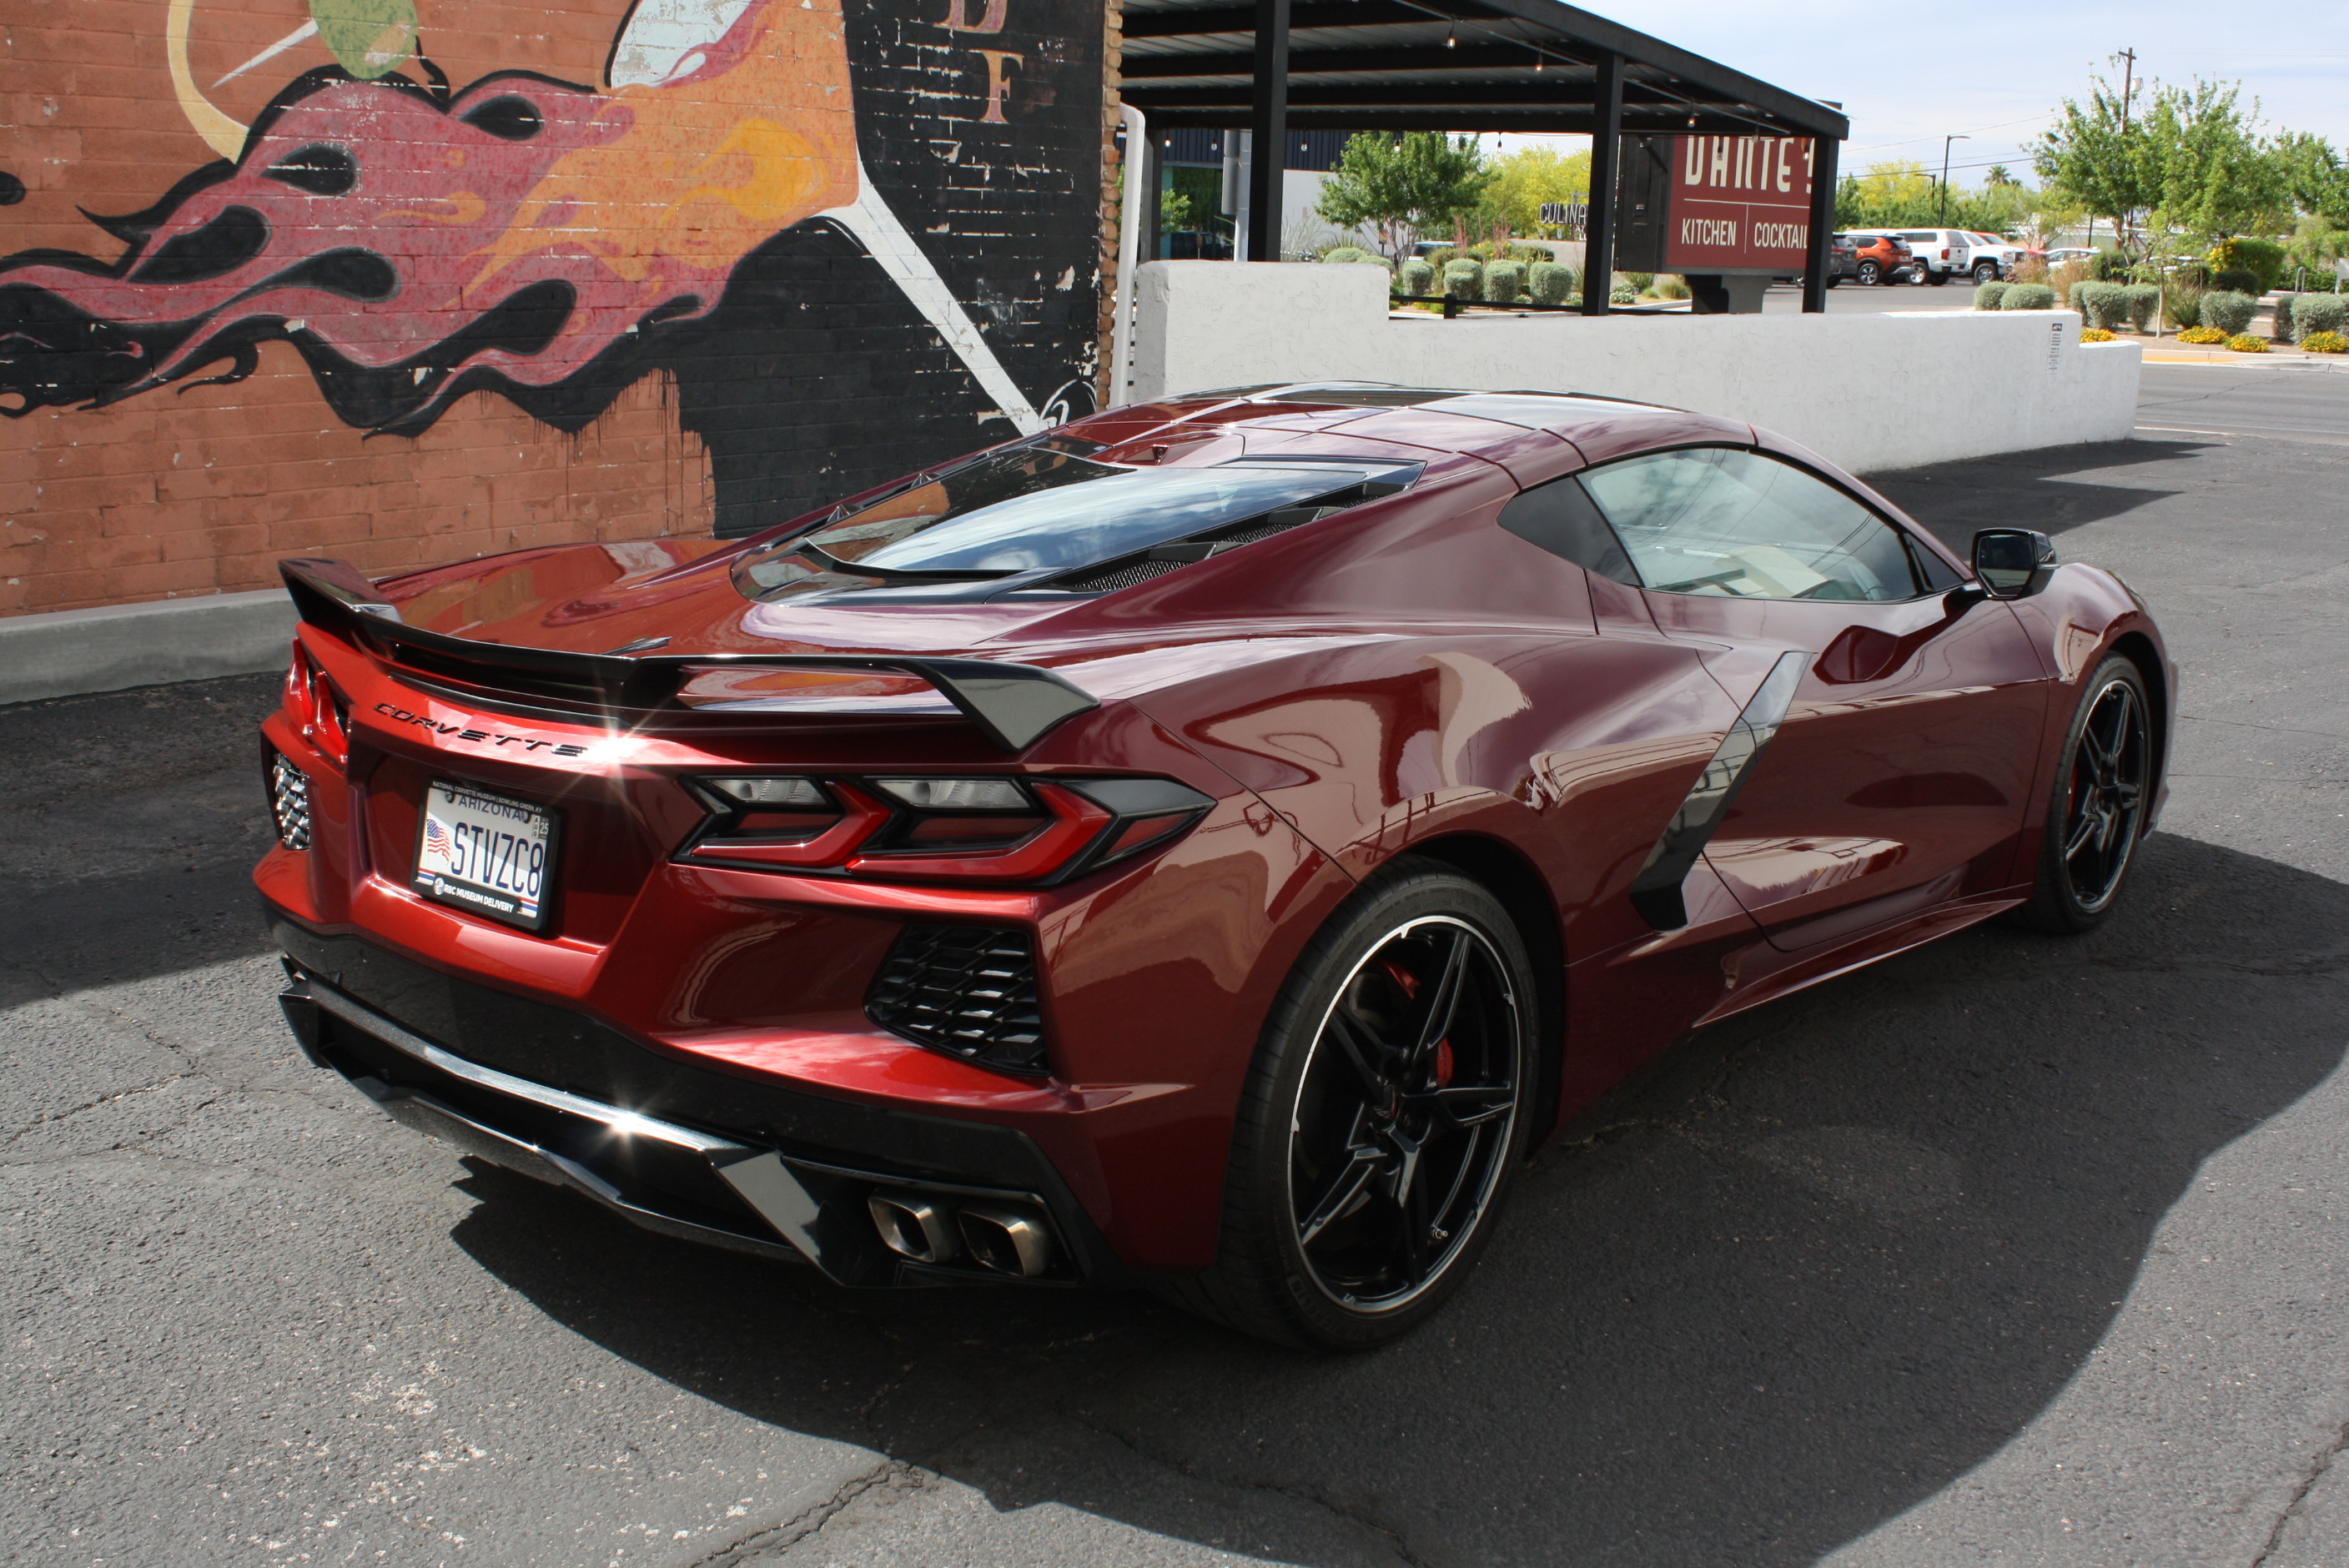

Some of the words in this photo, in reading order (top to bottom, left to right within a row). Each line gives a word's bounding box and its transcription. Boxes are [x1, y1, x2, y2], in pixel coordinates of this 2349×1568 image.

[1681, 218, 1737, 246] KITCHEN
[373, 702, 589, 757] CORVETTE
[432, 781, 455, 792] NATIONAL
[455, 786, 476, 797] CORVETTE
[476, 791, 496, 802] MUSEUM
[498, 797, 520, 807] BOWLING
[458, 795, 521, 822] ARIZONA
[540, 822, 549, 836] 25
[450, 822, 543, 897] STVZC8
[456, 887, 484, 903] MUSEUM
[484, 896, 515, 913] DELIVERY
